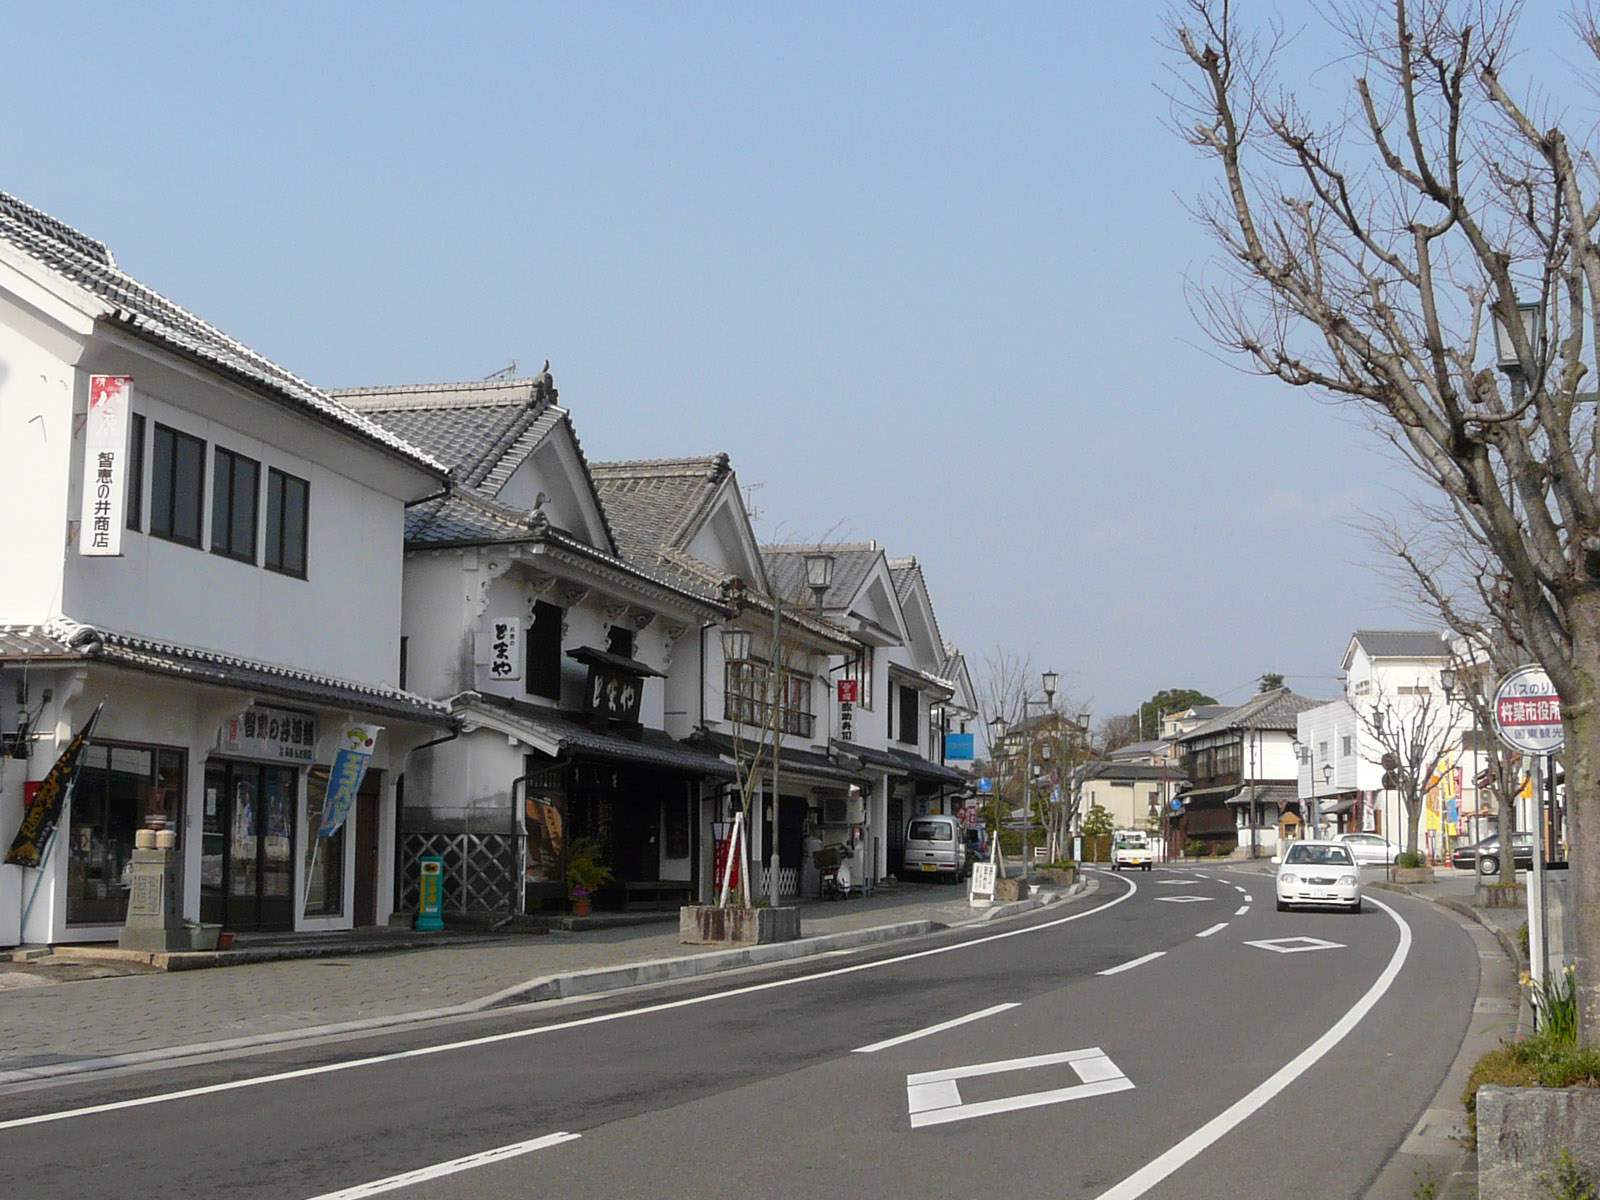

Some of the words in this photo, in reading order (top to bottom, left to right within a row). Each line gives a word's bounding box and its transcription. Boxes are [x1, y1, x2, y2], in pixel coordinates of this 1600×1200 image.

[92, 451, 114, 547] 智恵の井商店
[491, 623, 512, 677] とまや
